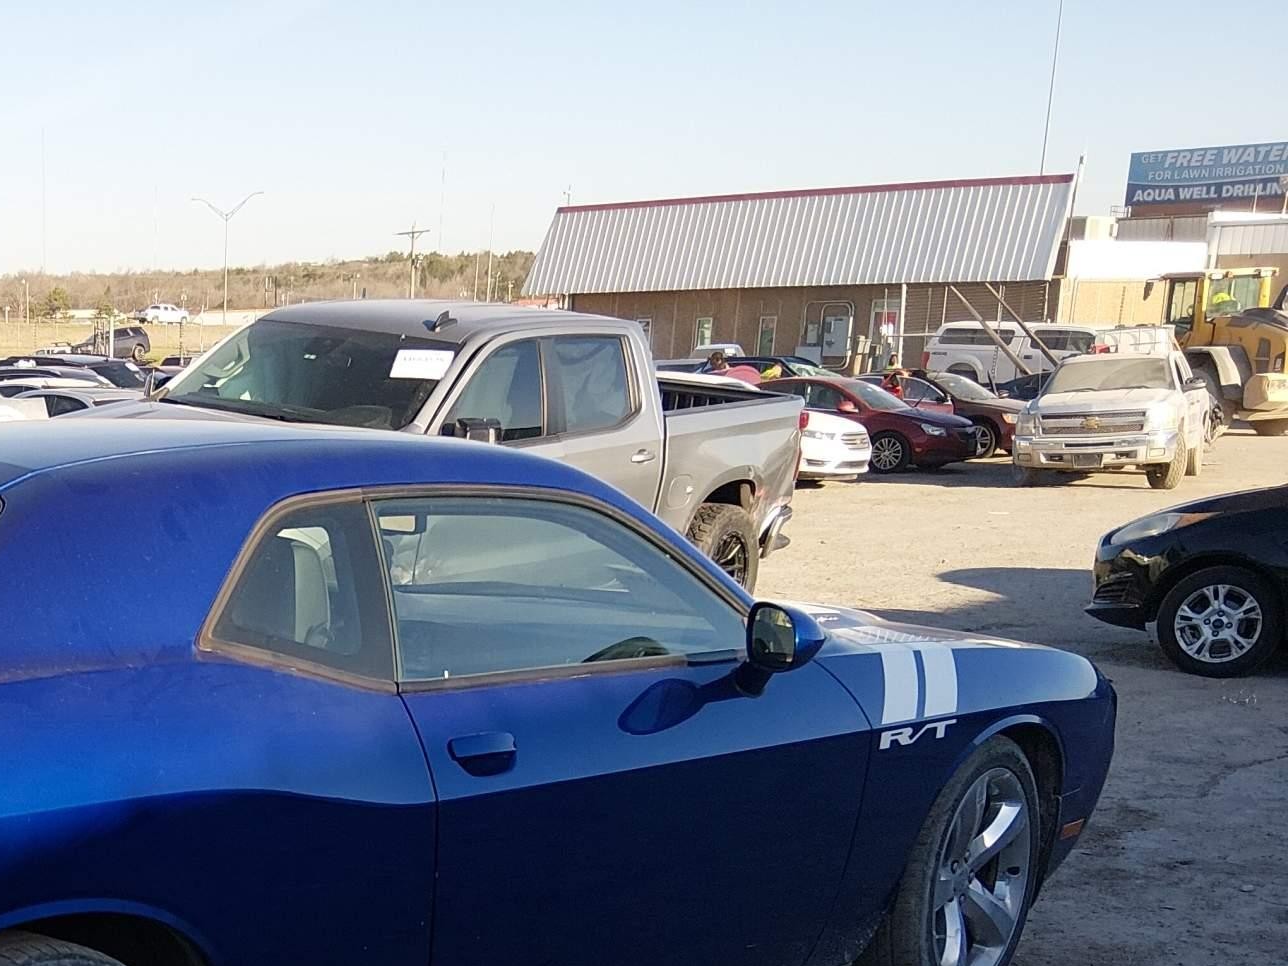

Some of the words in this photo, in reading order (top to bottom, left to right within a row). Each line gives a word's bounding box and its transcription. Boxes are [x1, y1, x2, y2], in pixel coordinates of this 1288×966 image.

[1141, 153, 1164, 165] GET
[1164, 150, 1218, 168] FREE
[1148, 170, 1172, 181] FOR
[1174, 167, 1210, 180] LAWN
[1212, 163, 1285, 177] IRRIGATION
[1132, 187, 1175, 202] AQUA
[1179, 184, 1218, 200] WELL
[1221, 182, 1283, 198] DRILLIN
[879, 719, 958, 750] R/T
